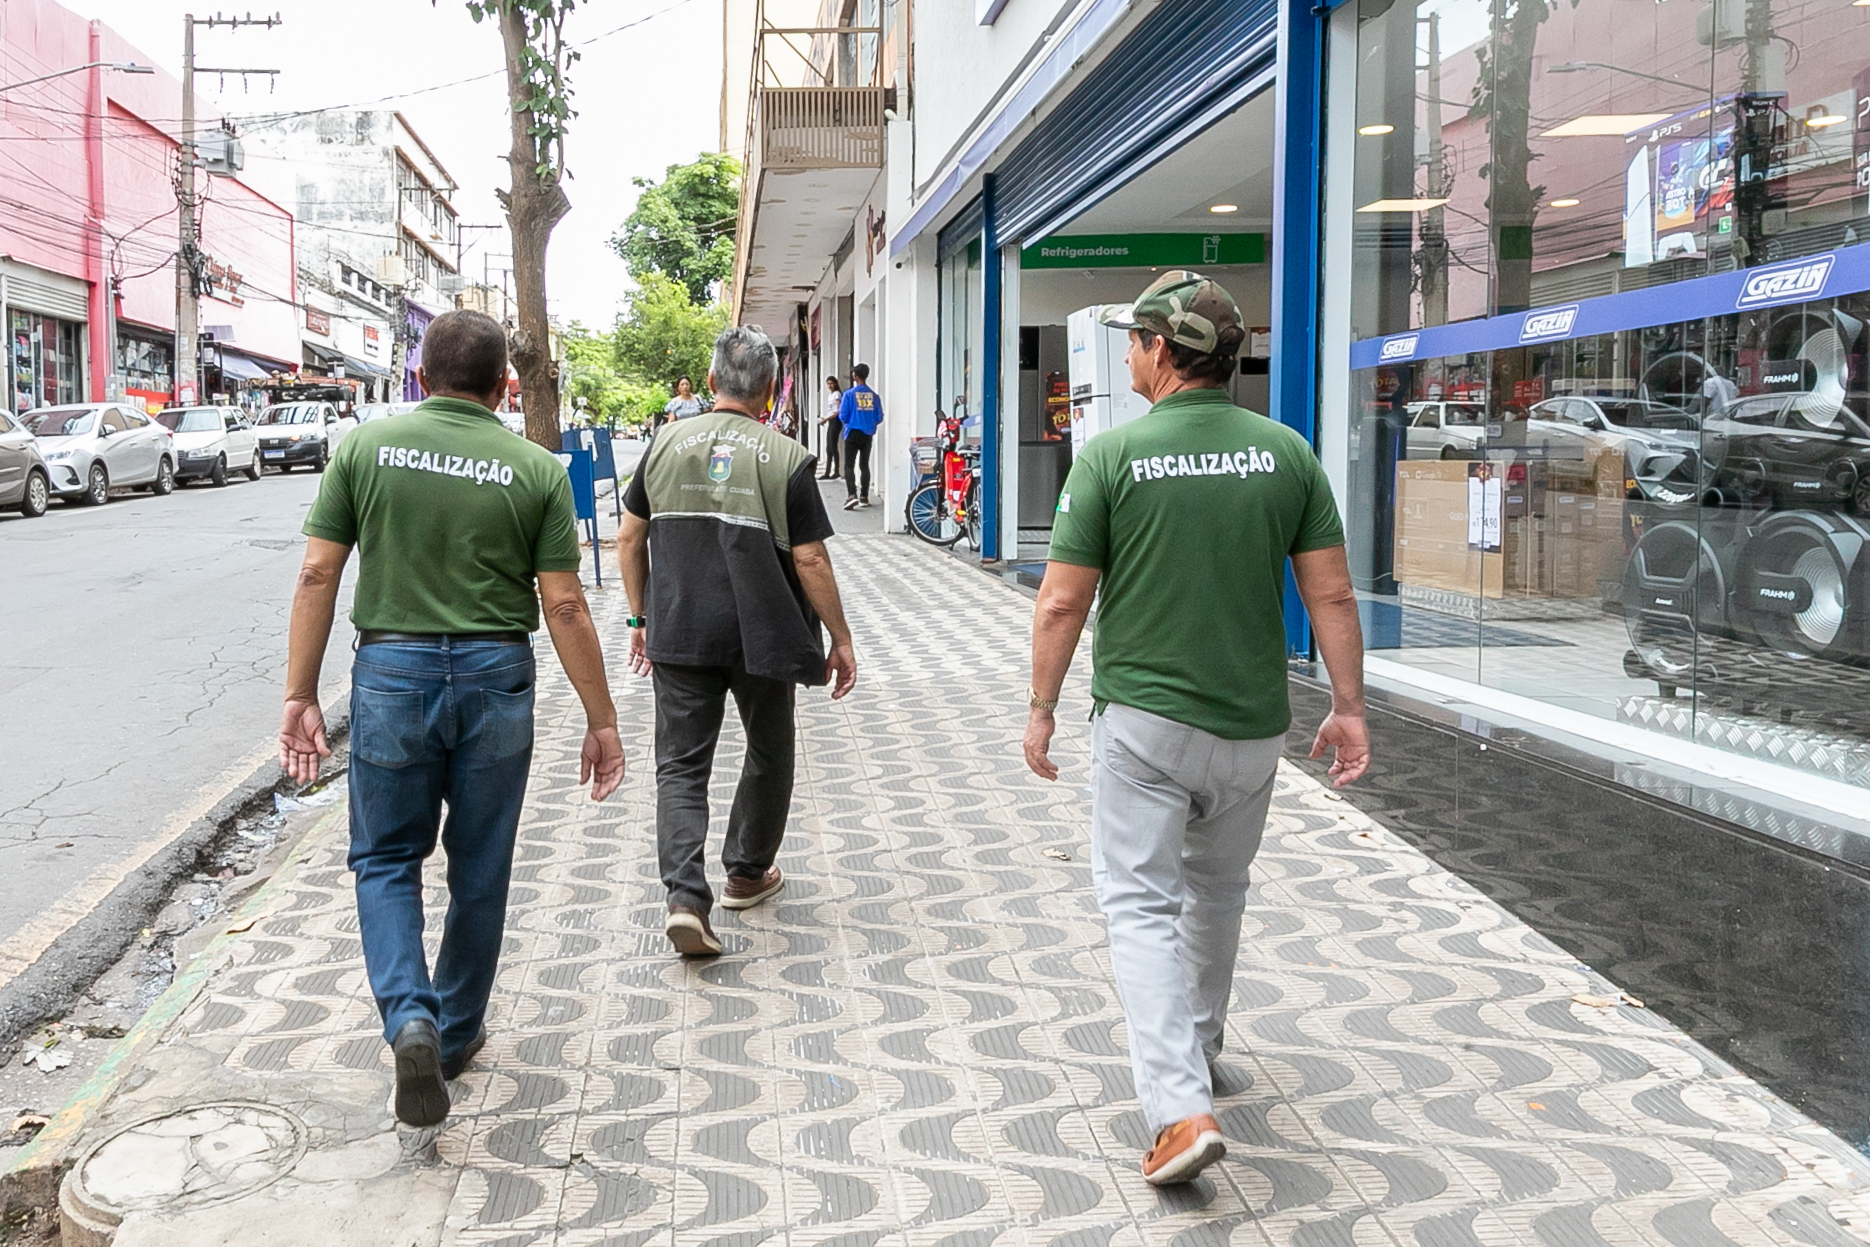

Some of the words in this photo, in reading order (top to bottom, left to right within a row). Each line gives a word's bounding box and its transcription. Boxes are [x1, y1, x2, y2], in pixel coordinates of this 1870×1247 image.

[1660, 122, 1682, 138] PS5
[1665, 196, 1687, 212] BOT
[1041, 246, 1129, 258] Refrigeradores
[1741, 261, 1830, 303] GAZIN
[1522, 309, 1576, 339] GAZIN
[1381, 336, 1418, 360] GAZIN
[1763, 375, 1792, 383] FRAHM
[674, 430, 770, 463] FISCALIZAÇÃO
[378, 446, 513, 486] FISCALIZAÇÃO
[1131, 446, 1276, 482] FISCALIZAÇÃO
[1760, 588, 1788, 599] FRAHM
